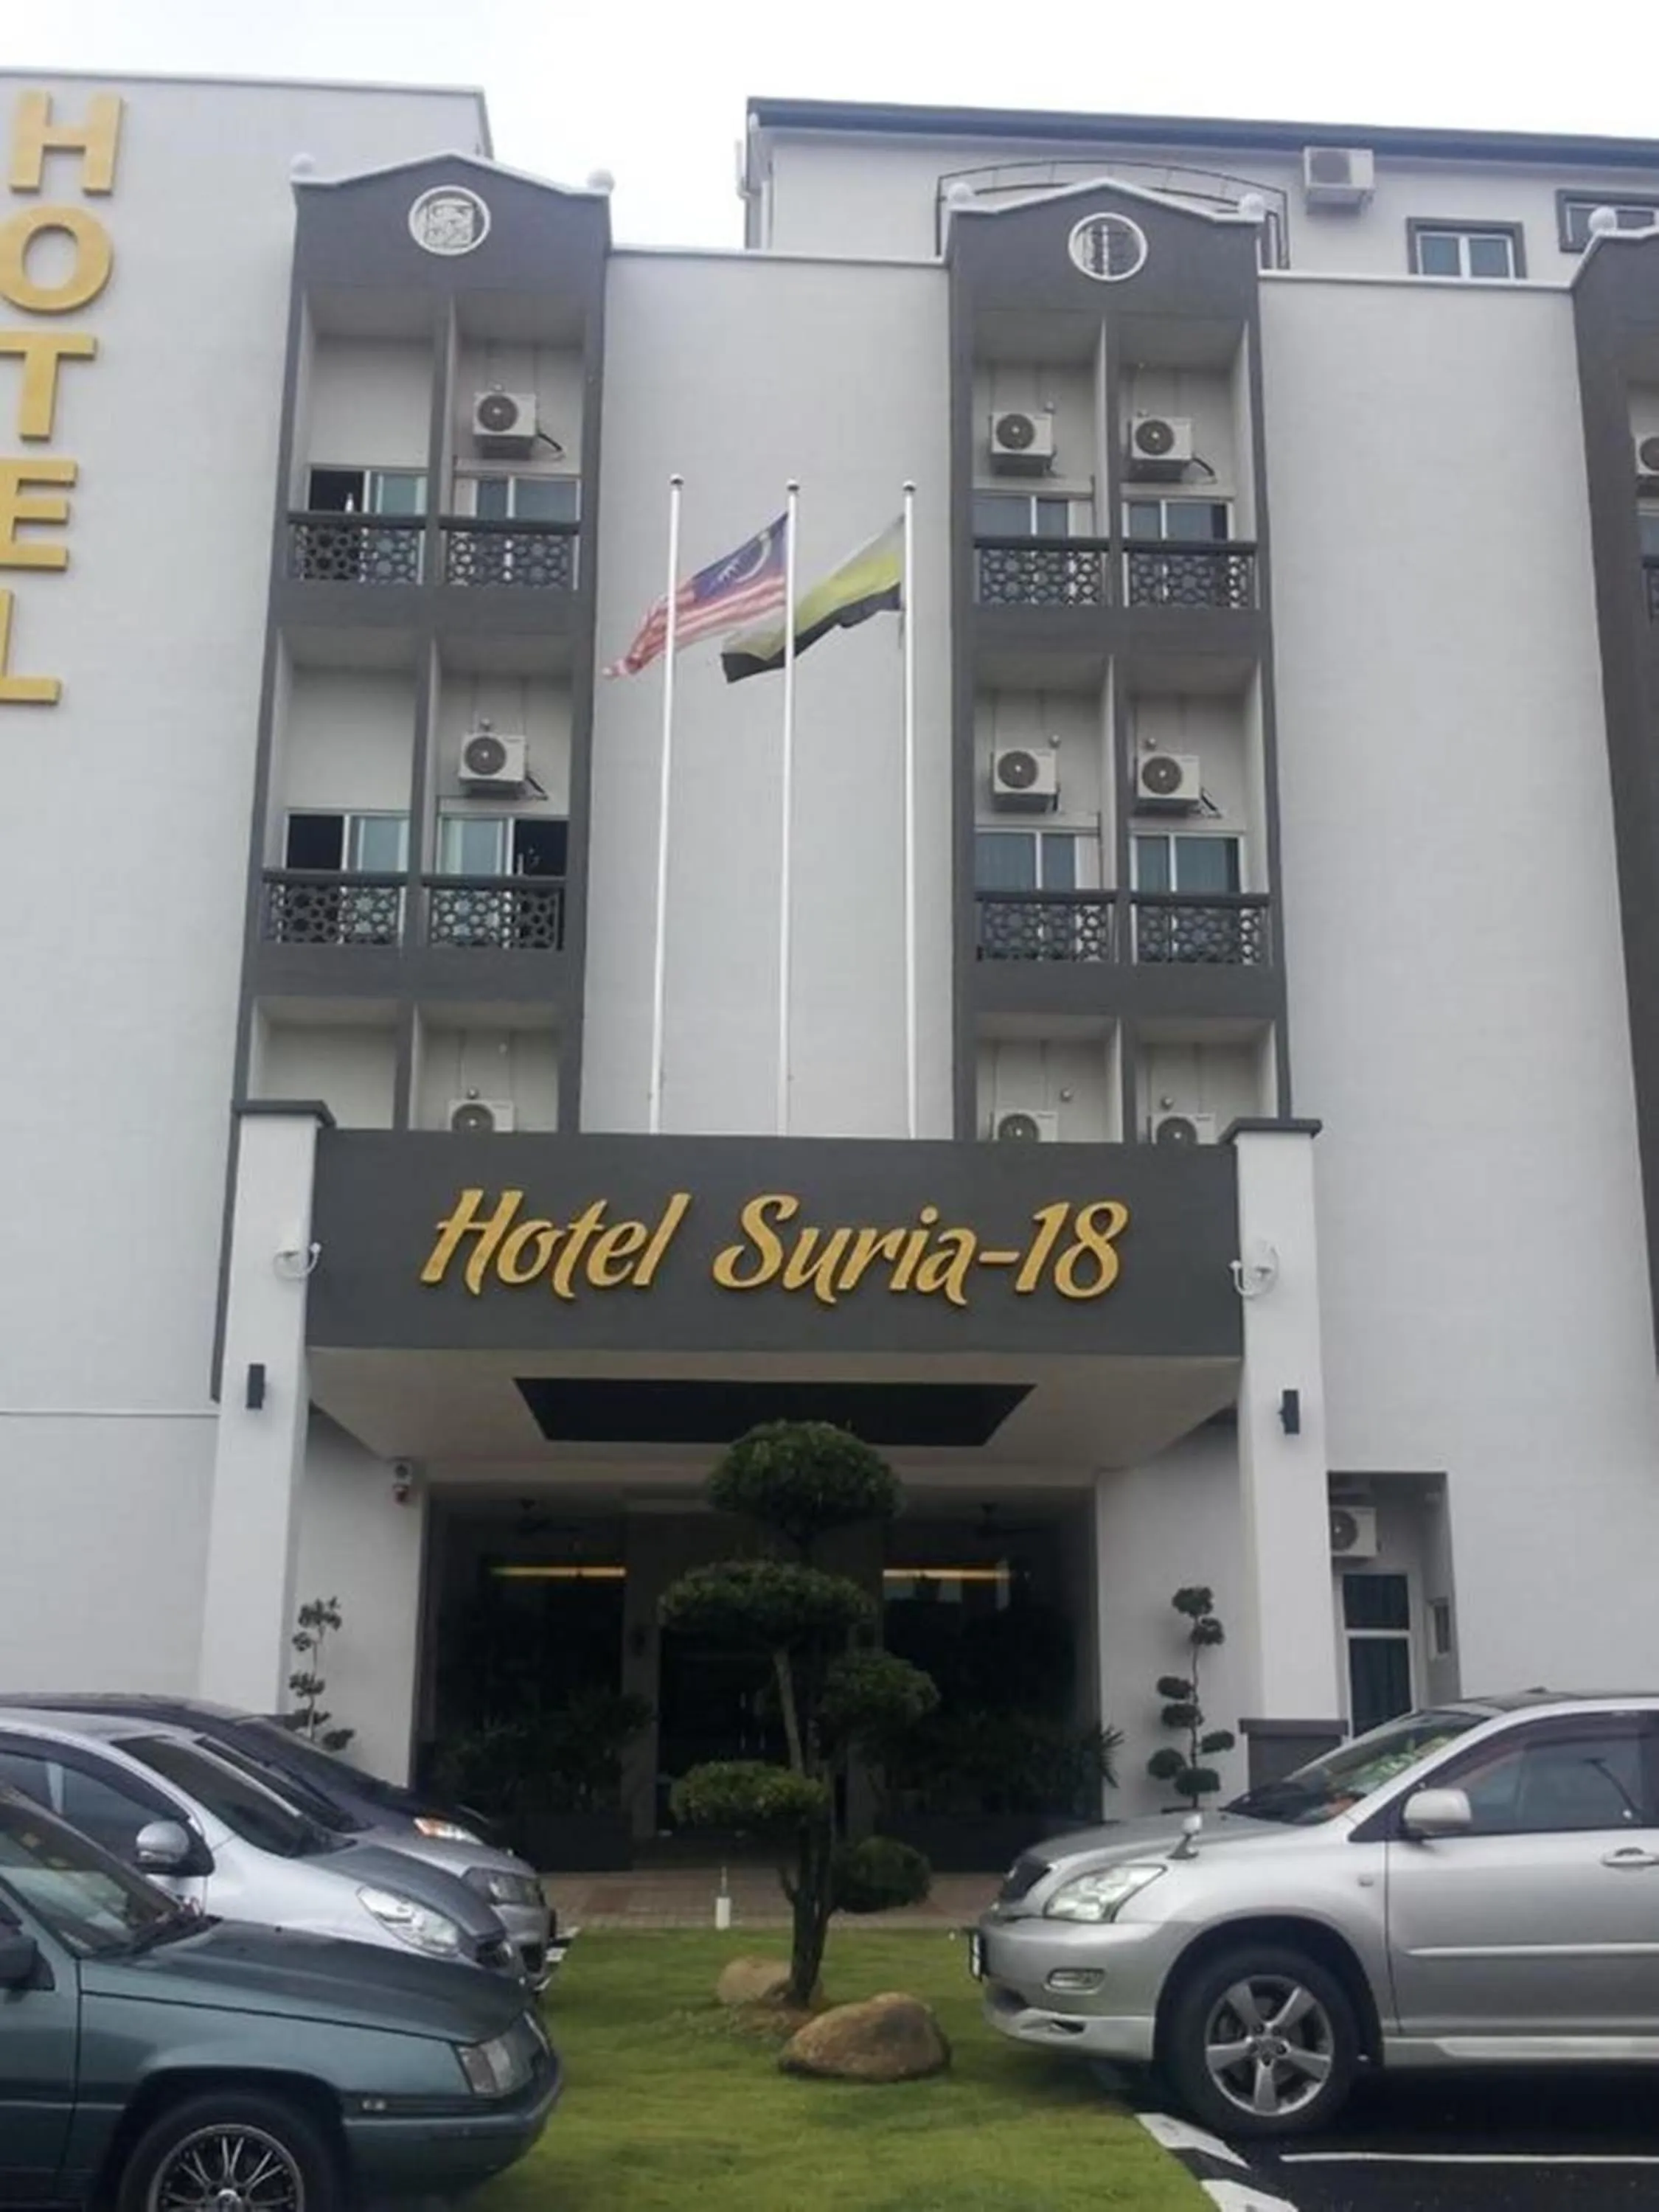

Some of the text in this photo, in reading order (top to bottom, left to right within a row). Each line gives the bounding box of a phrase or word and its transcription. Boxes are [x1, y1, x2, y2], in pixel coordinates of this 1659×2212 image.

[0, 89, 124, 704] HOTEL
[420, 1188, 1129, 1306] Hotel Suria-18
